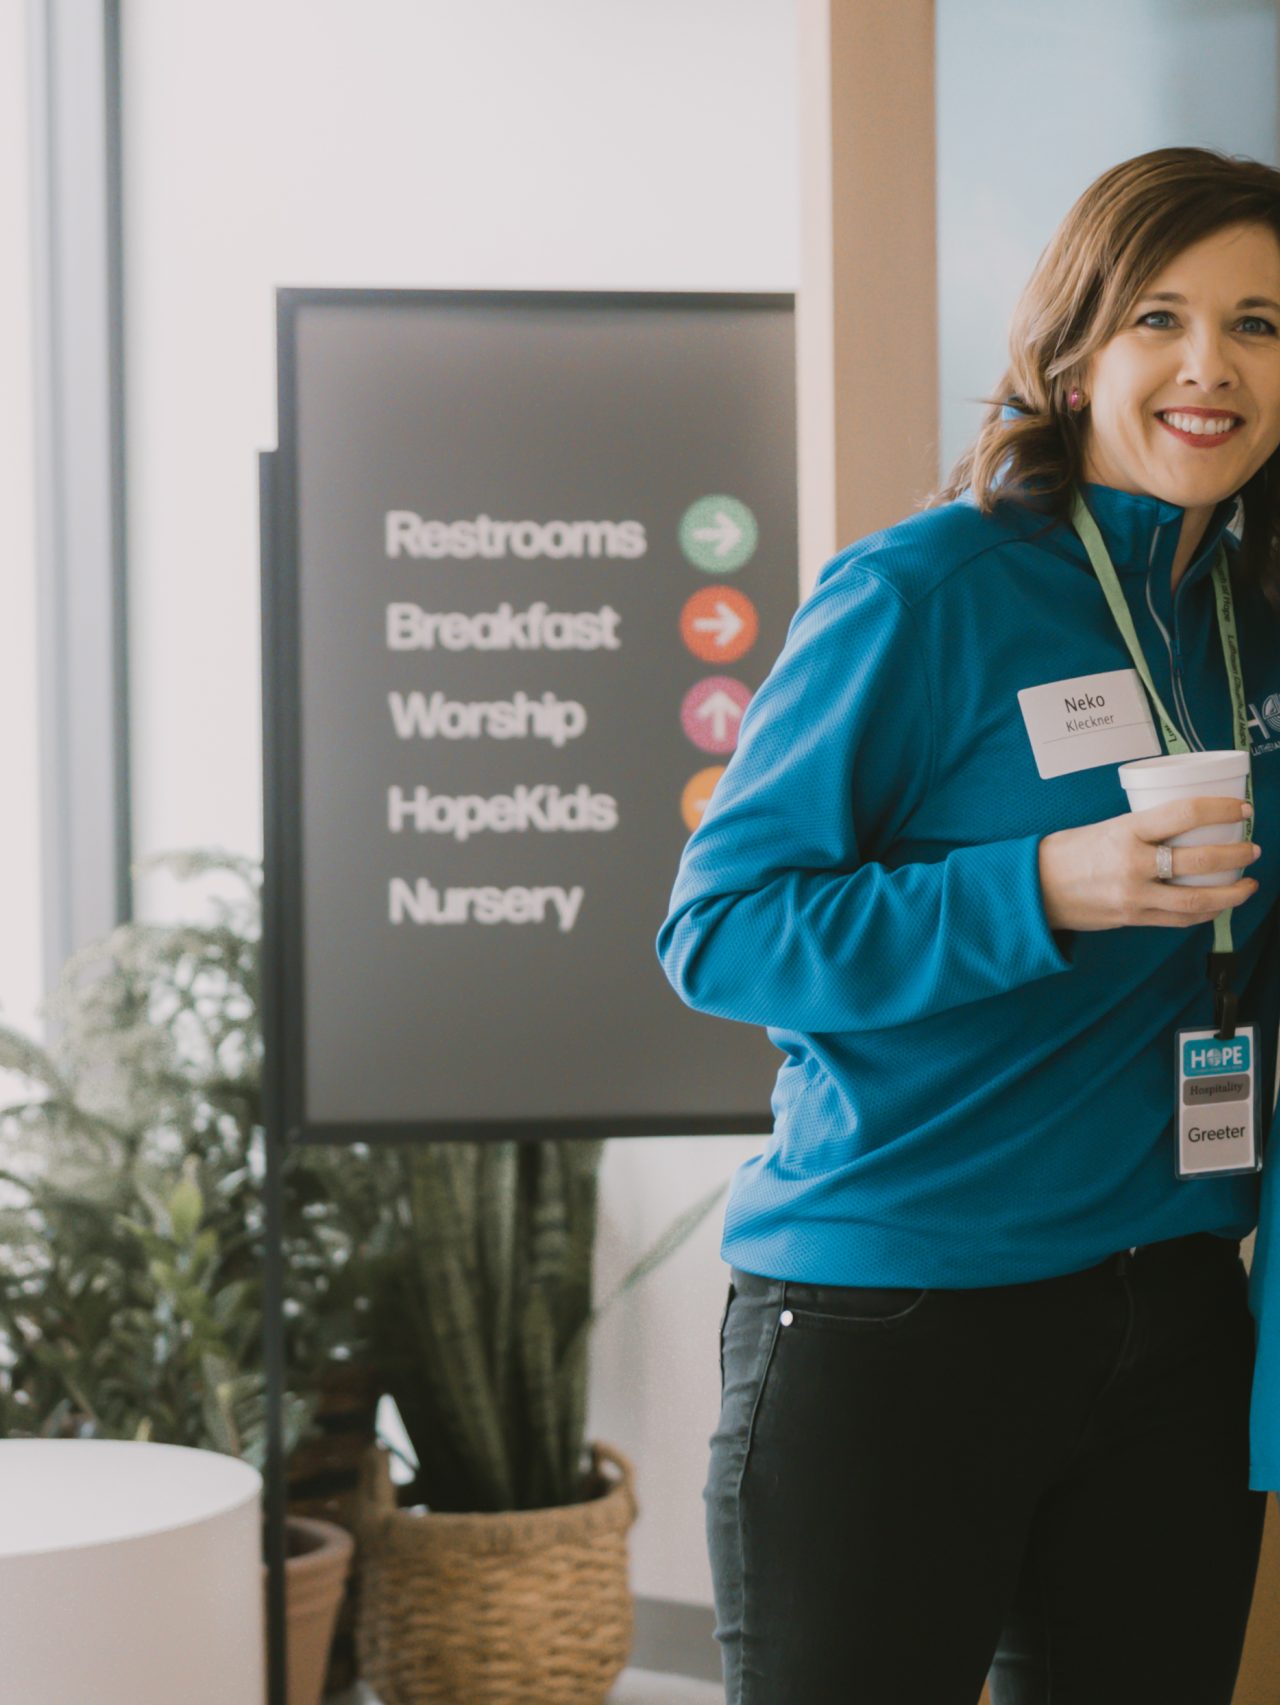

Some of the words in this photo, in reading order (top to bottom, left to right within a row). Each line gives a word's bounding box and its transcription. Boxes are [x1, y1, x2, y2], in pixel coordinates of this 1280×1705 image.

[385, 509, 647, 559] Restrooms
[1222, 596, 1231, 622] Hope
[386, 602, 621, 650] Breakfast
[1064, 693, 1106, 713] Neko
[388, 690, 588, 748] Worship
[1065, 713, 1115, 733] Kleckner
[387, 783, 619, 842] HopeKids
[389, 877, 584, 932] Nursery
[1190, 1046, 1243, 1068] HOPE
[1190, 1082, 1244, 1097] Hospitality
[1188, 1126, 1245, 1143] Greeter
